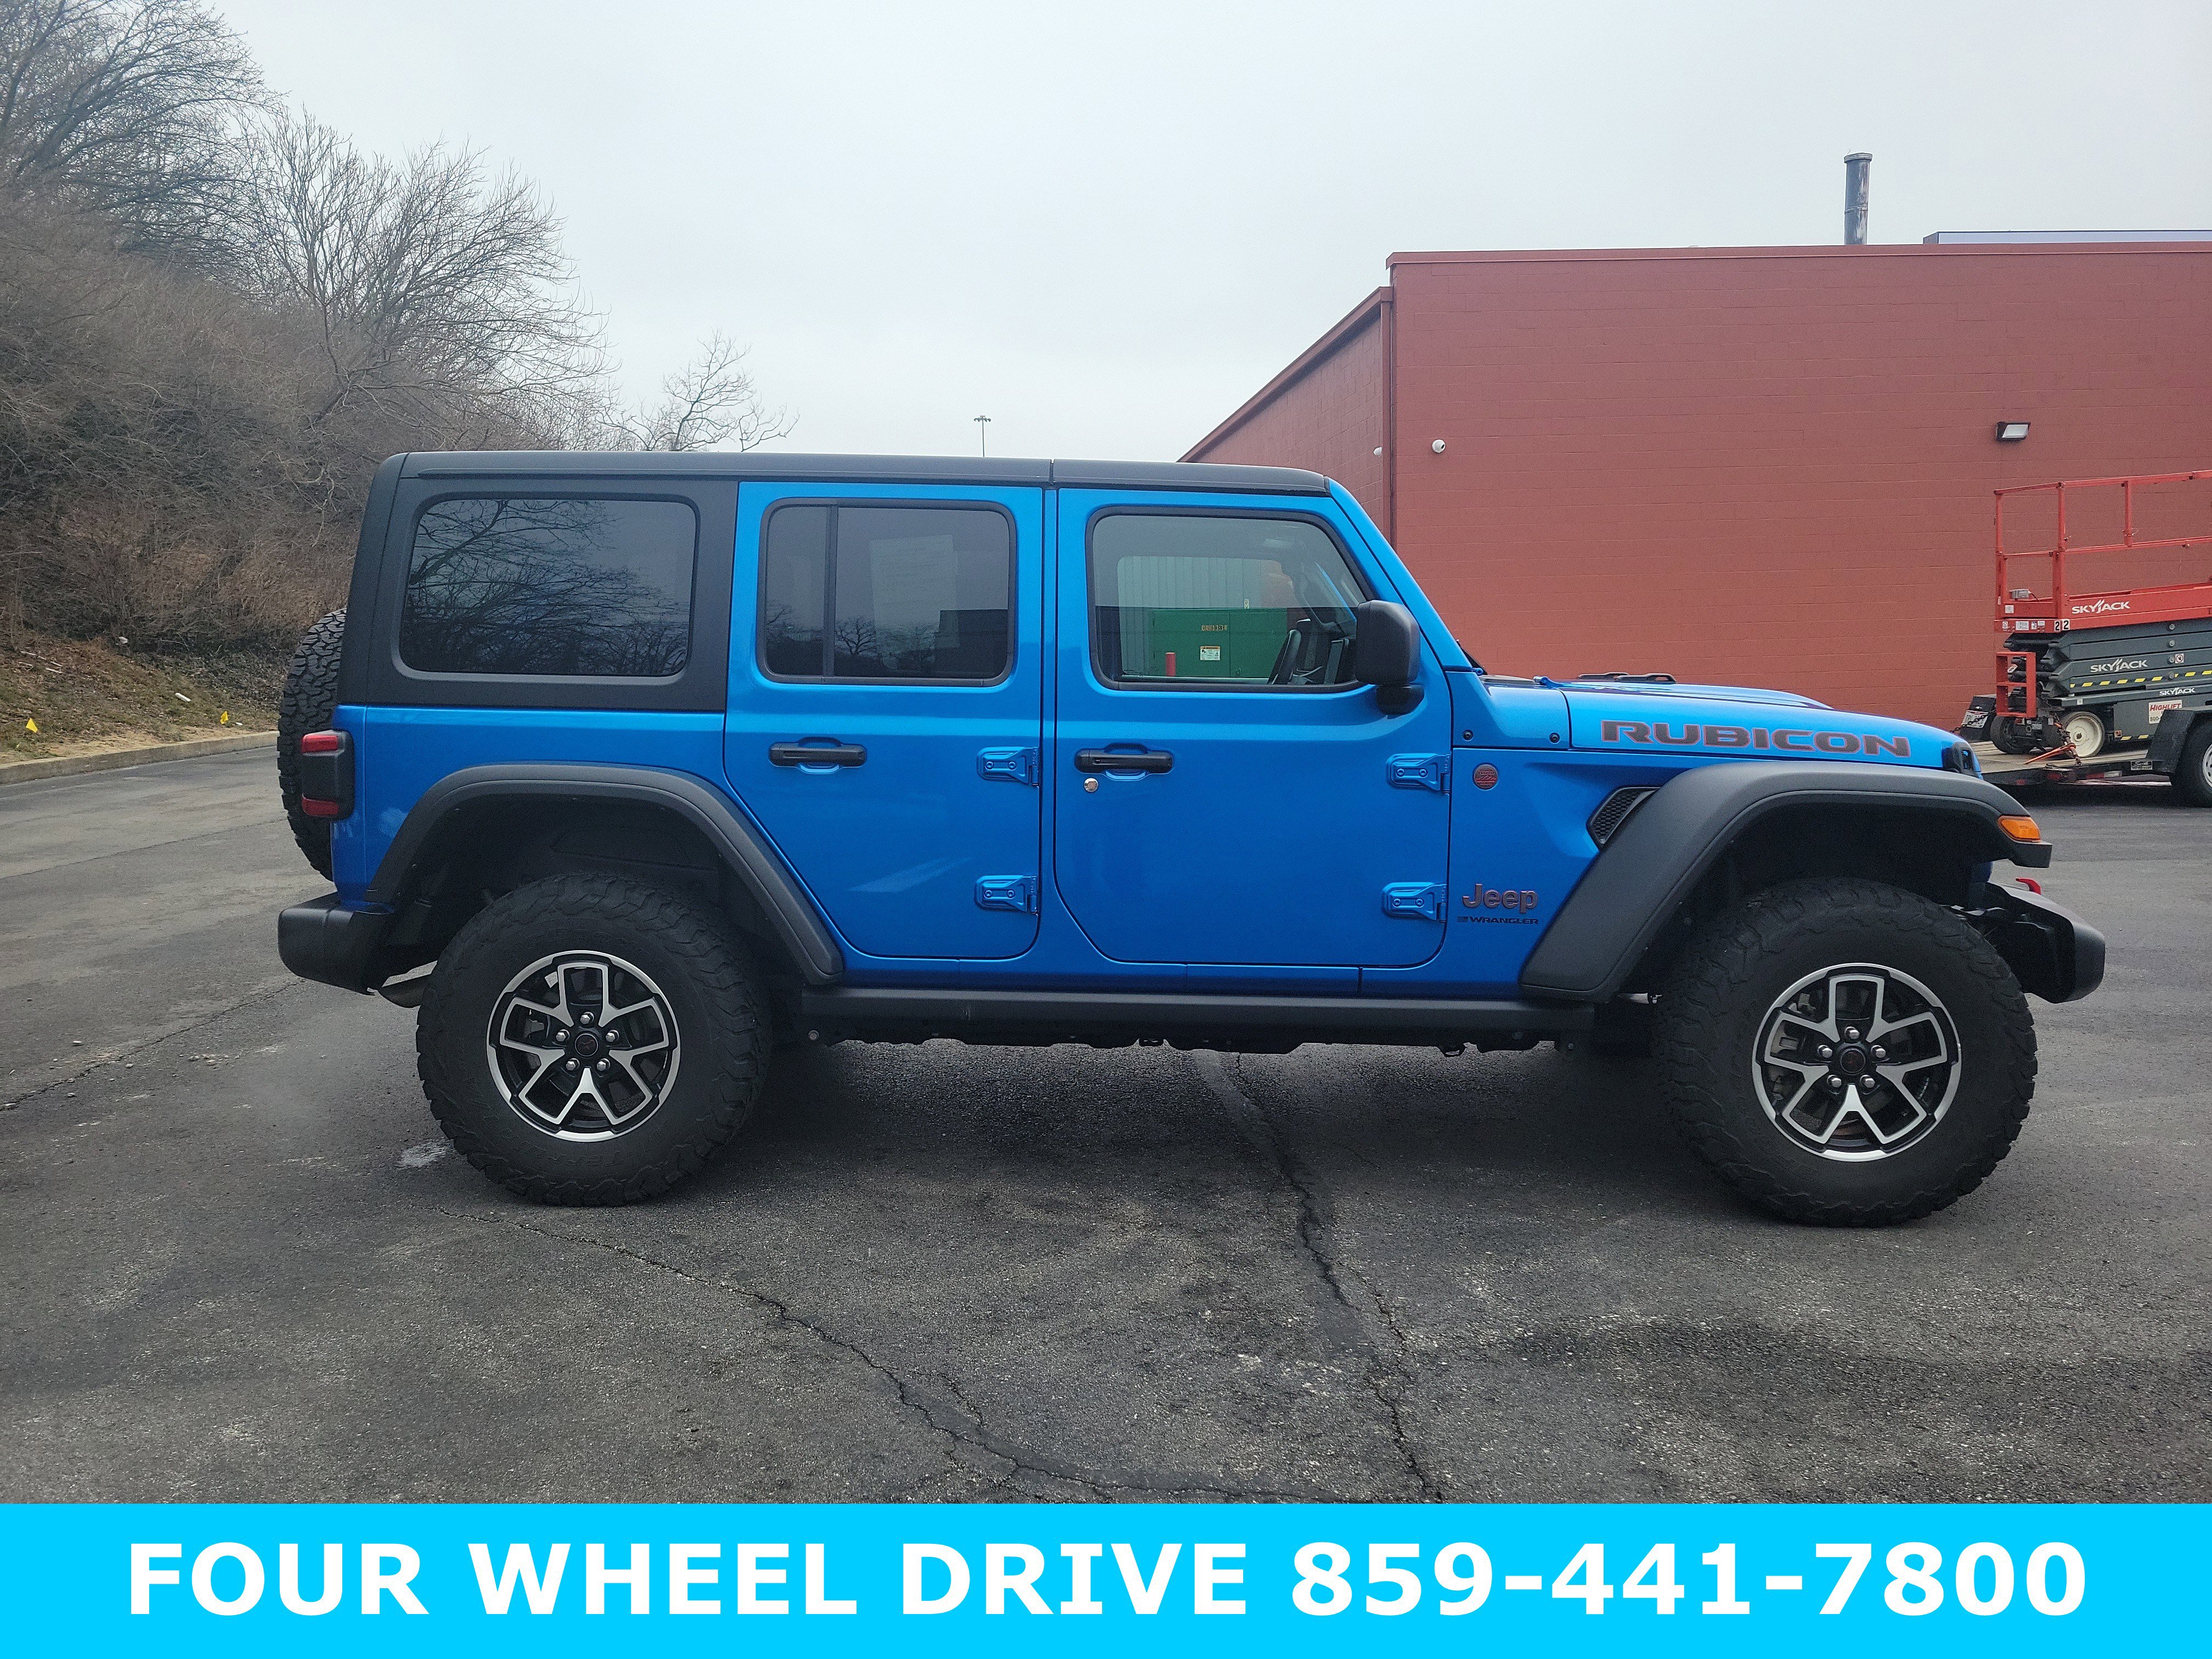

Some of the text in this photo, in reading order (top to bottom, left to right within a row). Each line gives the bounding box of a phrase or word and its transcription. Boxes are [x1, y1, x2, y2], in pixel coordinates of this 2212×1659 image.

[2072, 599, 2131, 613] SKYJACK
[2090, 658, 2148, 672] SKYJACK
[2159, 687, 2195, 696] SKYJACK
[1600, 720, 1911, 758] RUBICON
[1463, 884, 1538, 913] Jeep
